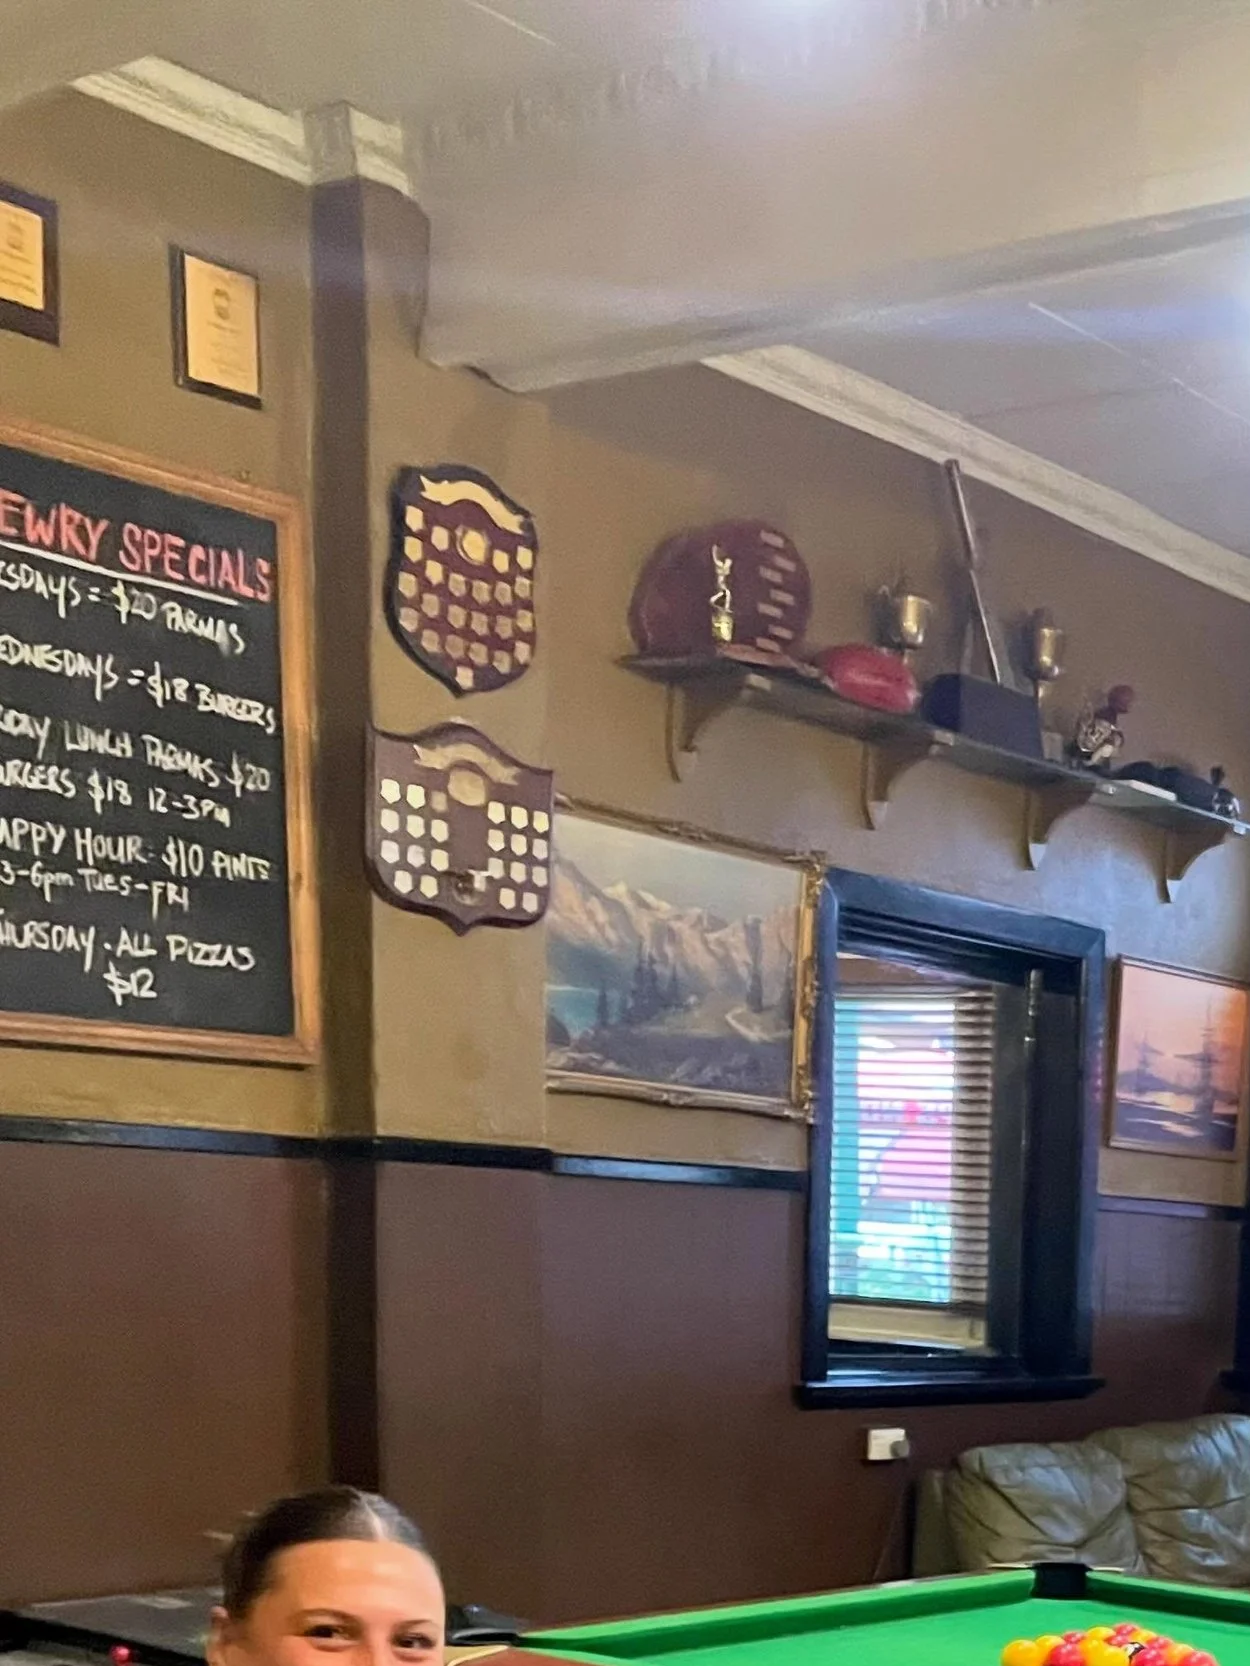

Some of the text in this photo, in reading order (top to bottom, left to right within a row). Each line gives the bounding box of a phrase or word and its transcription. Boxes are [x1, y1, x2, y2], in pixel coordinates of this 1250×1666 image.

[119, 521, 272, 603] SPECIALS
[147, 661, 189, 708] $18
[195, 683, 276, 734] BURGERS
[64, 720, 132, 758] LUNCH
[226, 752, 270, 798] $20
[87, 767, 132, 814] $18
[162, 835, 204, 878] $10
[116, 926, 157, 957] ALL
[166, 934, 255, 971] PIZZAS
[103, 960, 157, 1006] $12
